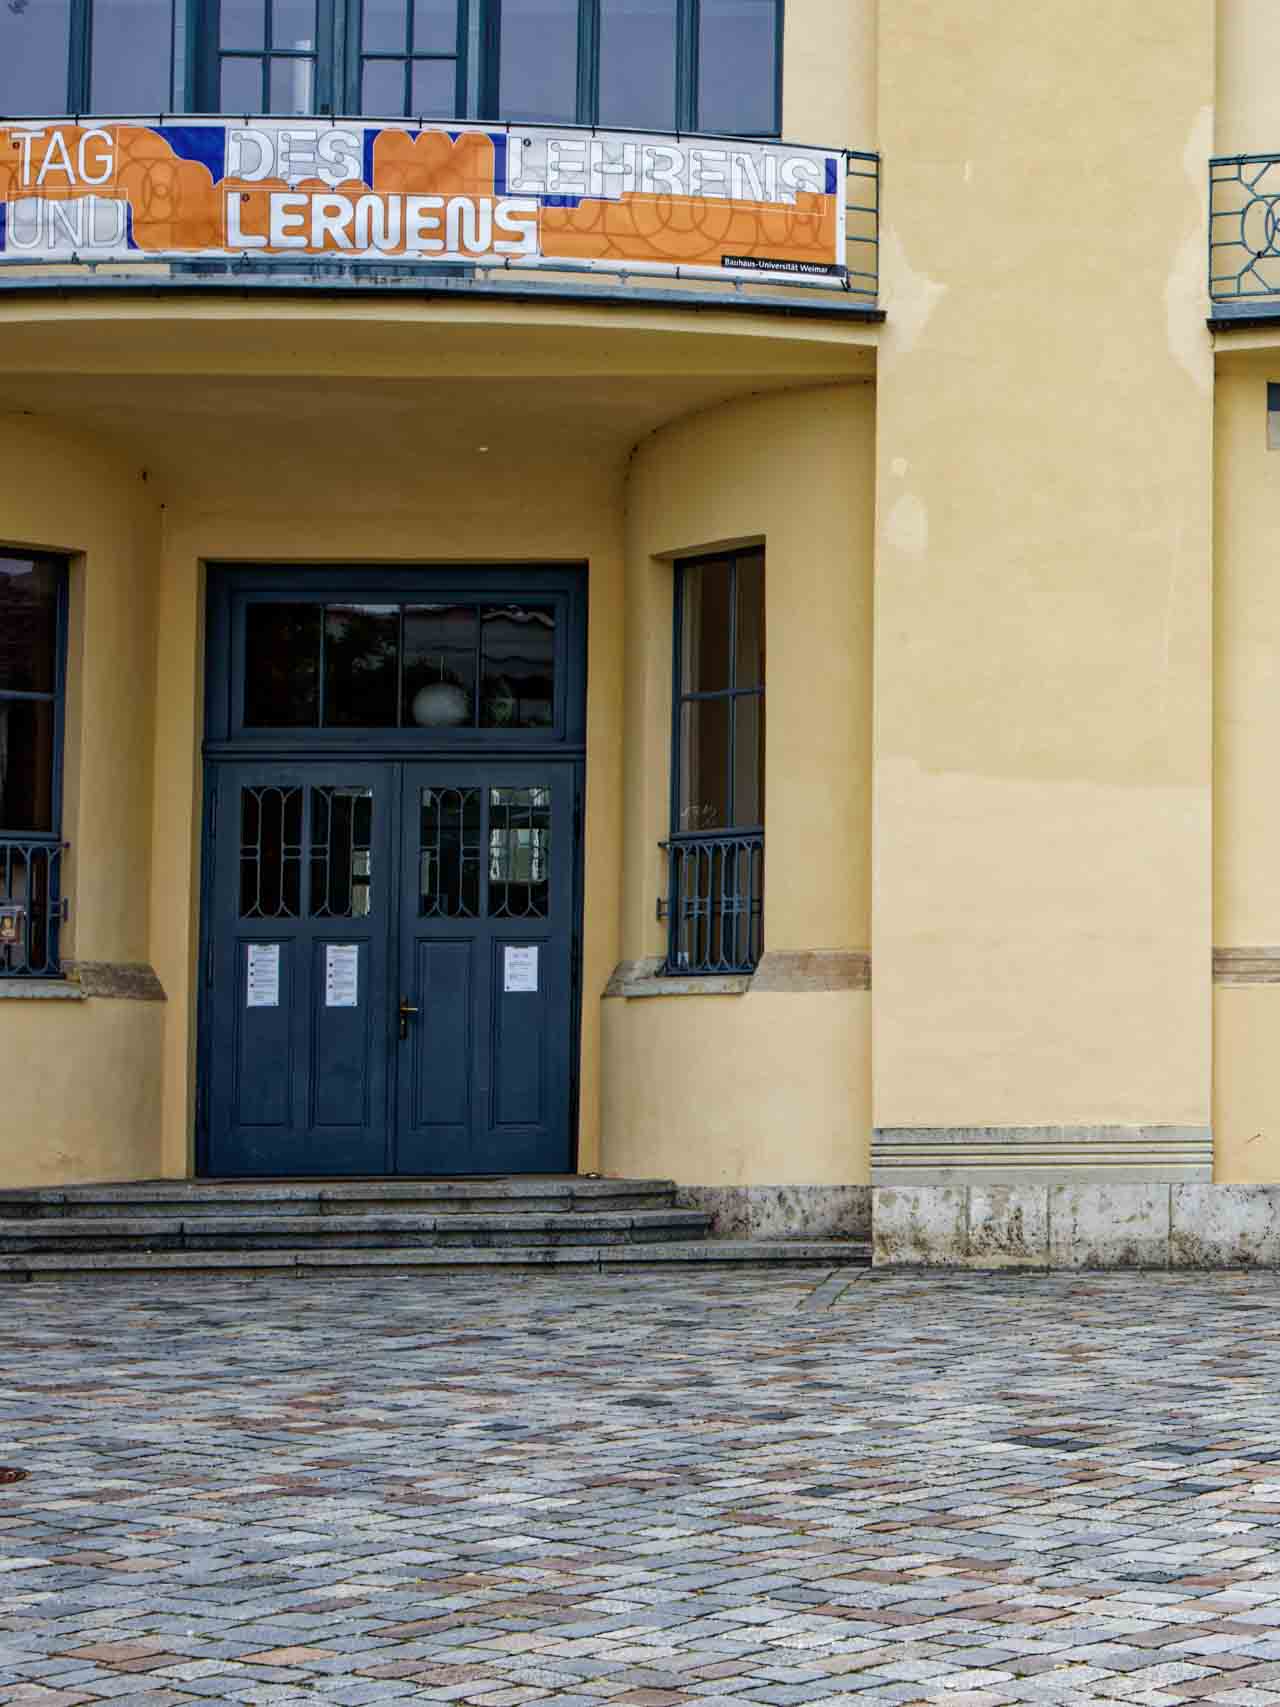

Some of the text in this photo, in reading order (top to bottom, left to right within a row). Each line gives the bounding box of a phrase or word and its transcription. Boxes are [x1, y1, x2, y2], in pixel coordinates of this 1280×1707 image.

[10, 128, 825, 205] TAG DES LEHRENS
[7, 192, 539, 257] UND LERNENS
[724, 256, 829, 274] Bauhaus-Universität Weimar
